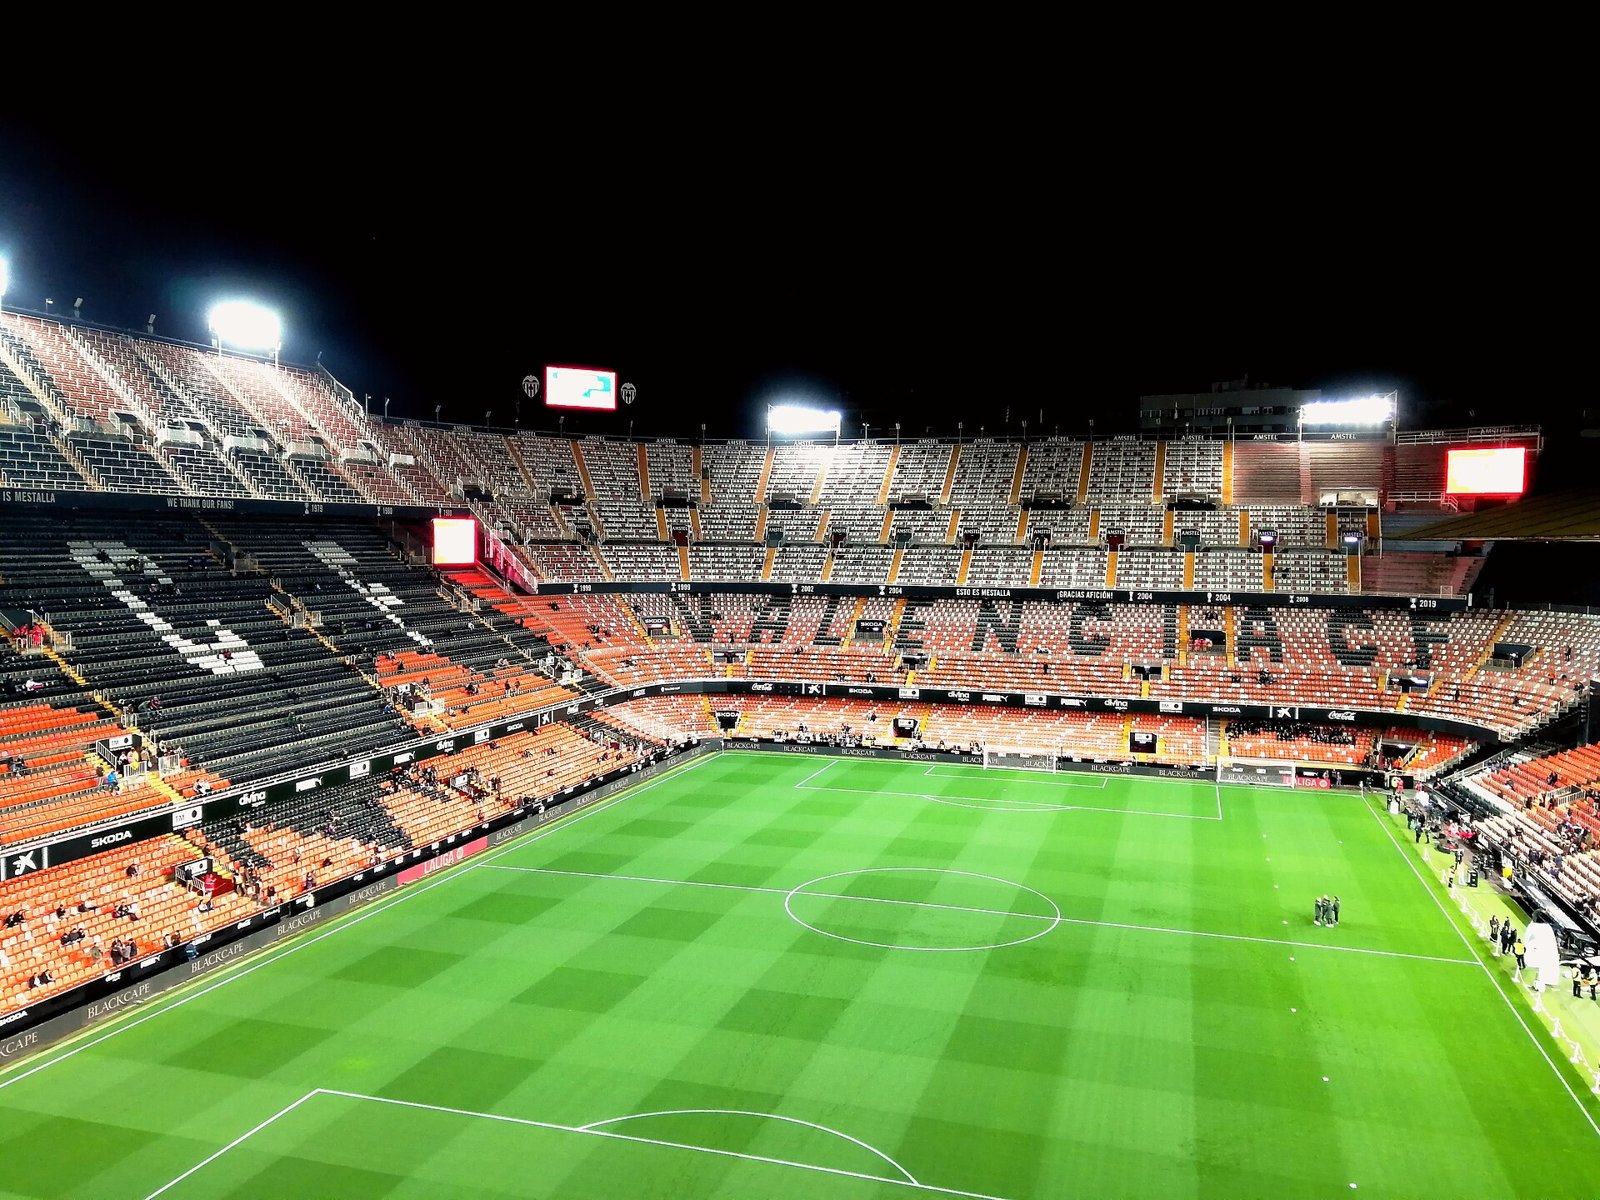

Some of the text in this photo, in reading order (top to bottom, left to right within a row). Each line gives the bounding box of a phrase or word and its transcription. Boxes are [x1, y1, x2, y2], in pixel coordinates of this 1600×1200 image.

[2, 491, 56, 503] IS MESTALLA
[167, 498, 234, 510] WE THANK OUR FANS!
[982, 589, 1011, 597] MESTALLA
[1057, 590, 1114, 599] ¡GRACIAS AFICIÓN!
[1419, 599, 1436, 608] 2019
[1104, 699, 1128, 707] divina
[1091, 765, 1130, 773] BLACKCAPE
[239, 791, 266, 805] divina
[538, 807, 562, 822] BLACKCAPE
[91, 831, 132, 848] SKODA
[496, 824, 522, 841] BLACKCAPE
[424, 854, 454, 874] LALIGA
[349, 882, 386, 904] BLACKCAPE
[277, 910, 321, 936] BLACKCAPE
[191, 943, 244, 973] BLACKCAPE
[88, 983, 150, 1019] BLACKCAPE
